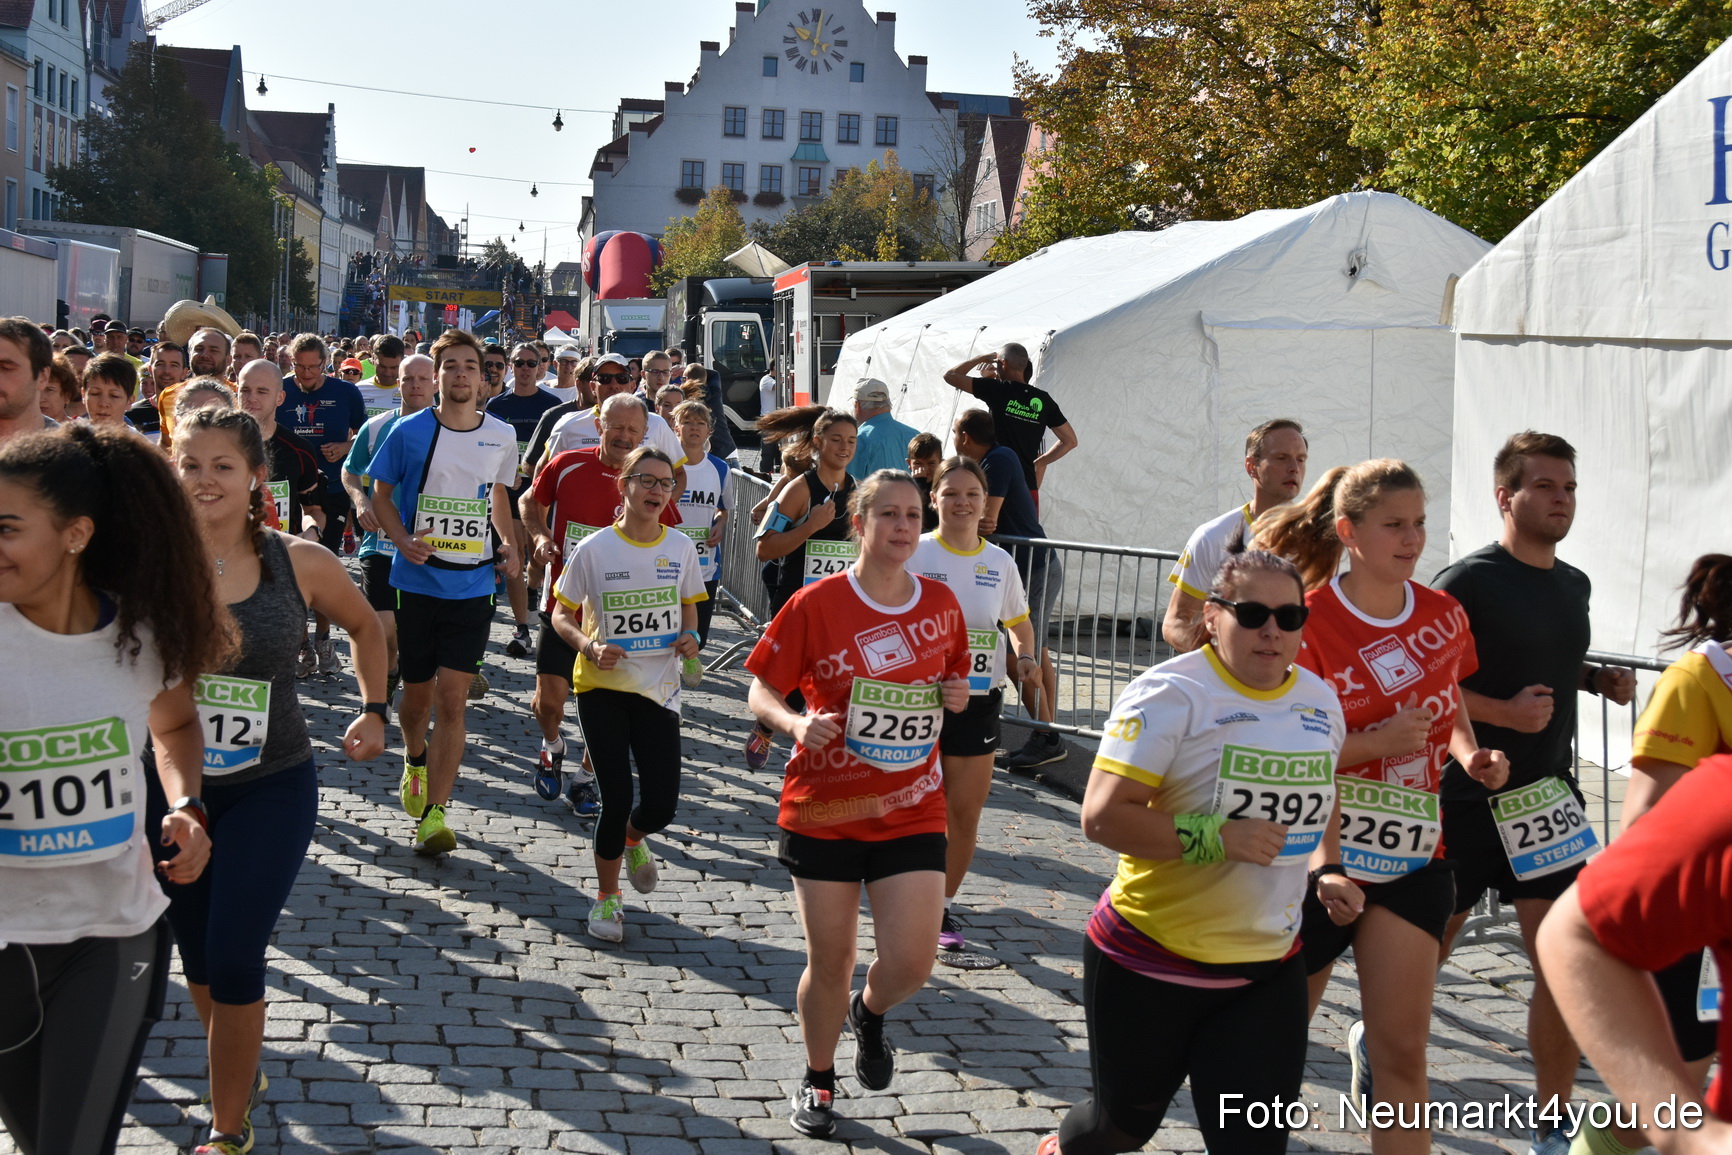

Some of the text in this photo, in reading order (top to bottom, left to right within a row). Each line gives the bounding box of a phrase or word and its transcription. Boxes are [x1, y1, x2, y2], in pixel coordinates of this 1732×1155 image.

[425, 290, 464, 302] START
[445, 304, 458, 312] 209
[1005, 406, 1040, 420] neumarkt
[1007, 399, 1030, 411] physio
[423, 496, 482, 516] BOCK
[425, 516, 478, 538] 1136
[431, 540, 467, 551] LUKAS
[811, 543, 856, 556] BOCK
[656, 558, 669, 568] 20
[975, 565, 987, 574] 20
[605, 571, 630, 579] BOCK
[608, 588, 674, 610] BOCK
[613, 610, 672, 635] 2641
[630, 638, 661, 650] JULE
[858, 626, 899, 645] raumbox
[1364, 638, 1399, 661] raumbox
[859, 682, 940, 708] BOCK
[858, 711, 935, 741] 2263
[1108, 716, 1143, 743] 20
[0, 721, 119, 767] OCK
[860, 744, 924, 761] KAROLIN
[828, 769, 872, 784] outdoor
[1229, 749, 1328, 783] BOCK
[794, 793, 881, 823] Team
[1227, 788, 1324, 827] 2392
[1336, 779, 1431, 819] BOCK
[1499, 780, 1567, 819] BOCK
[1340, 813, 1423, 852] 2261
[1511, 802, 1581, 849] 2396
[19, 828, 95, 853] HANA
[1533, 836, 1585, 866] STEFAN
